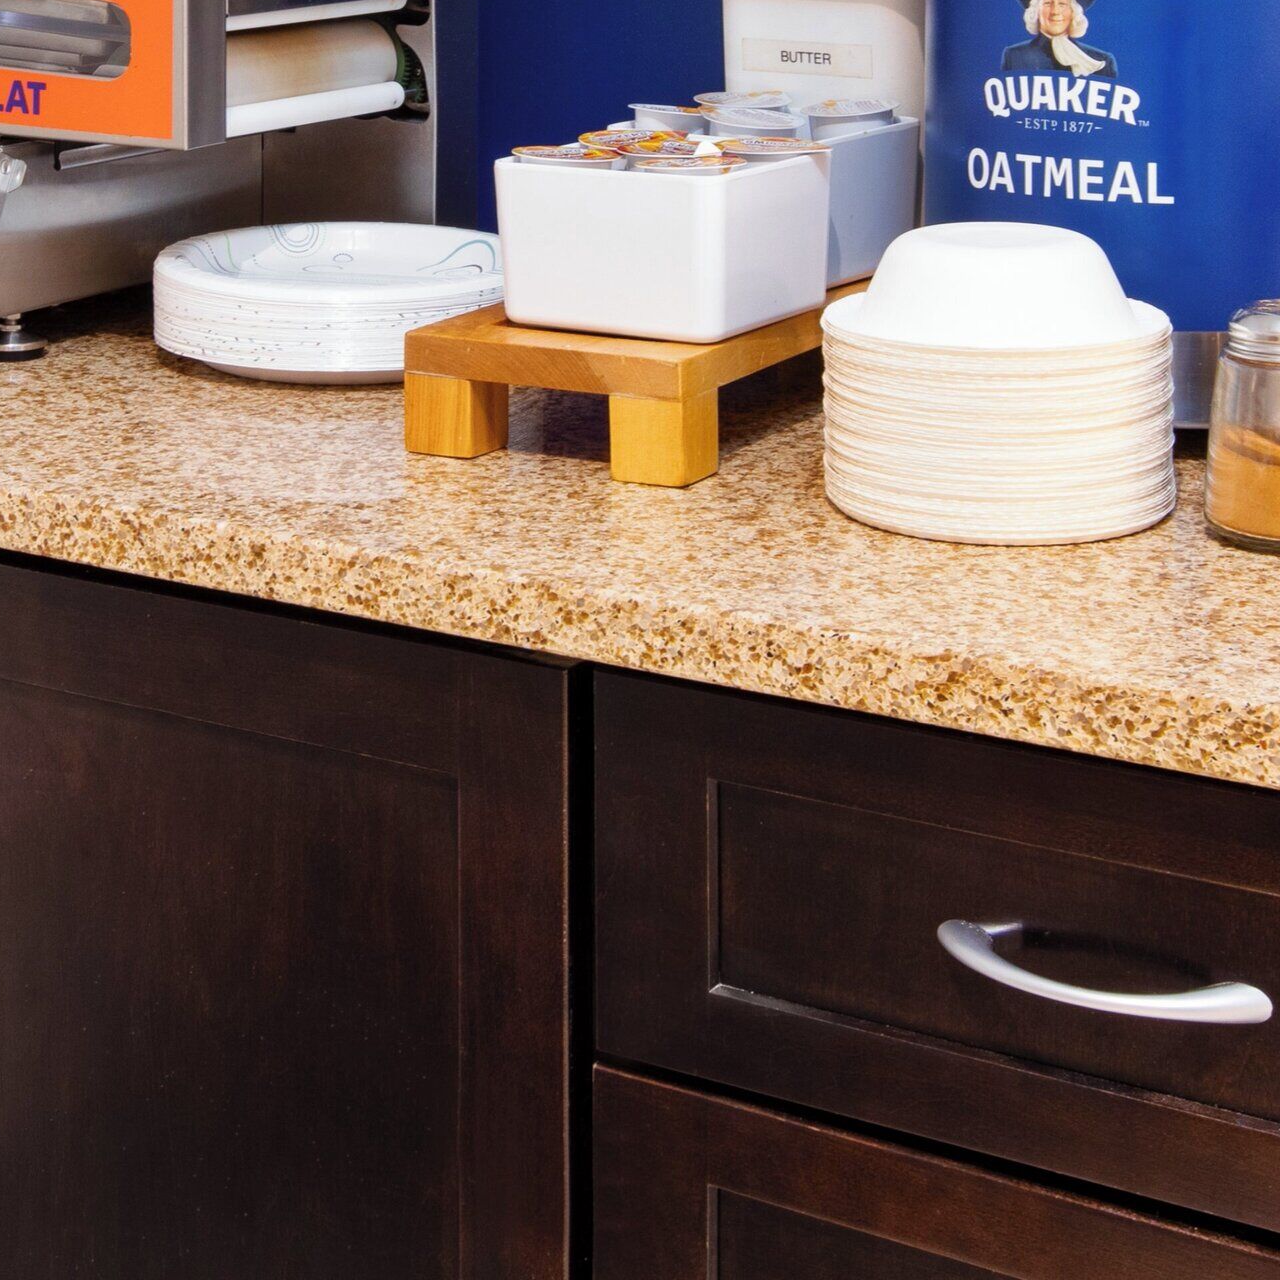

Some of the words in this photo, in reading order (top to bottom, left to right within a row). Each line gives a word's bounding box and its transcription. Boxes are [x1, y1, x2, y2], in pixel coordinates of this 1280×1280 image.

[780, 50, 832, 65] BUTTER
[983, 75, 1140, 126] QUAKER
[967, 146, 1176, 206] OATMEAL
